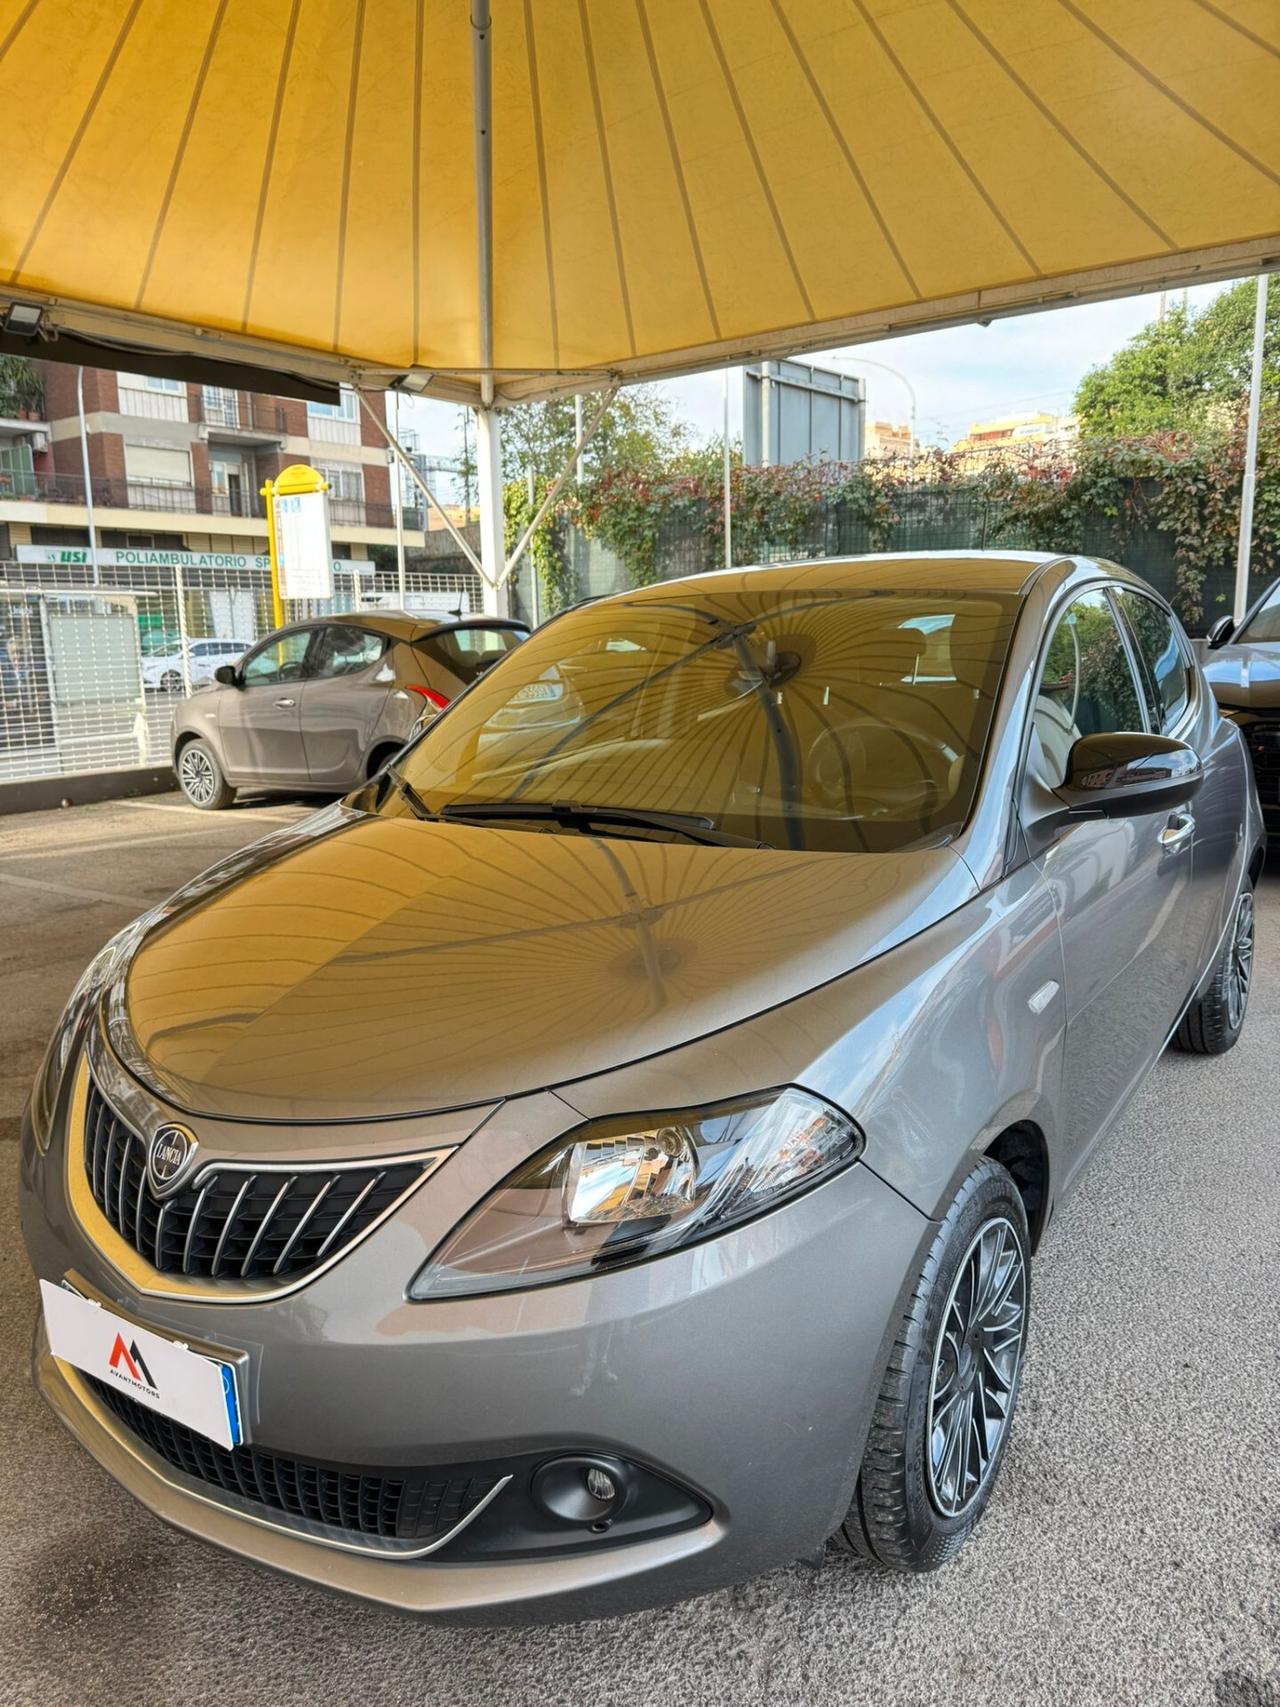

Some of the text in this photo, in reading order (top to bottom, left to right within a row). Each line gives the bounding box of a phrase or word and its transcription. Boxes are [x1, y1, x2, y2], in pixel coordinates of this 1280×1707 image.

[115, 550, 247, 568] POLIAMBULATORIO
[156, 1143, 182, 1165] LANCIA
[110, 1368, 160, 1399] AVANTMOTORS
